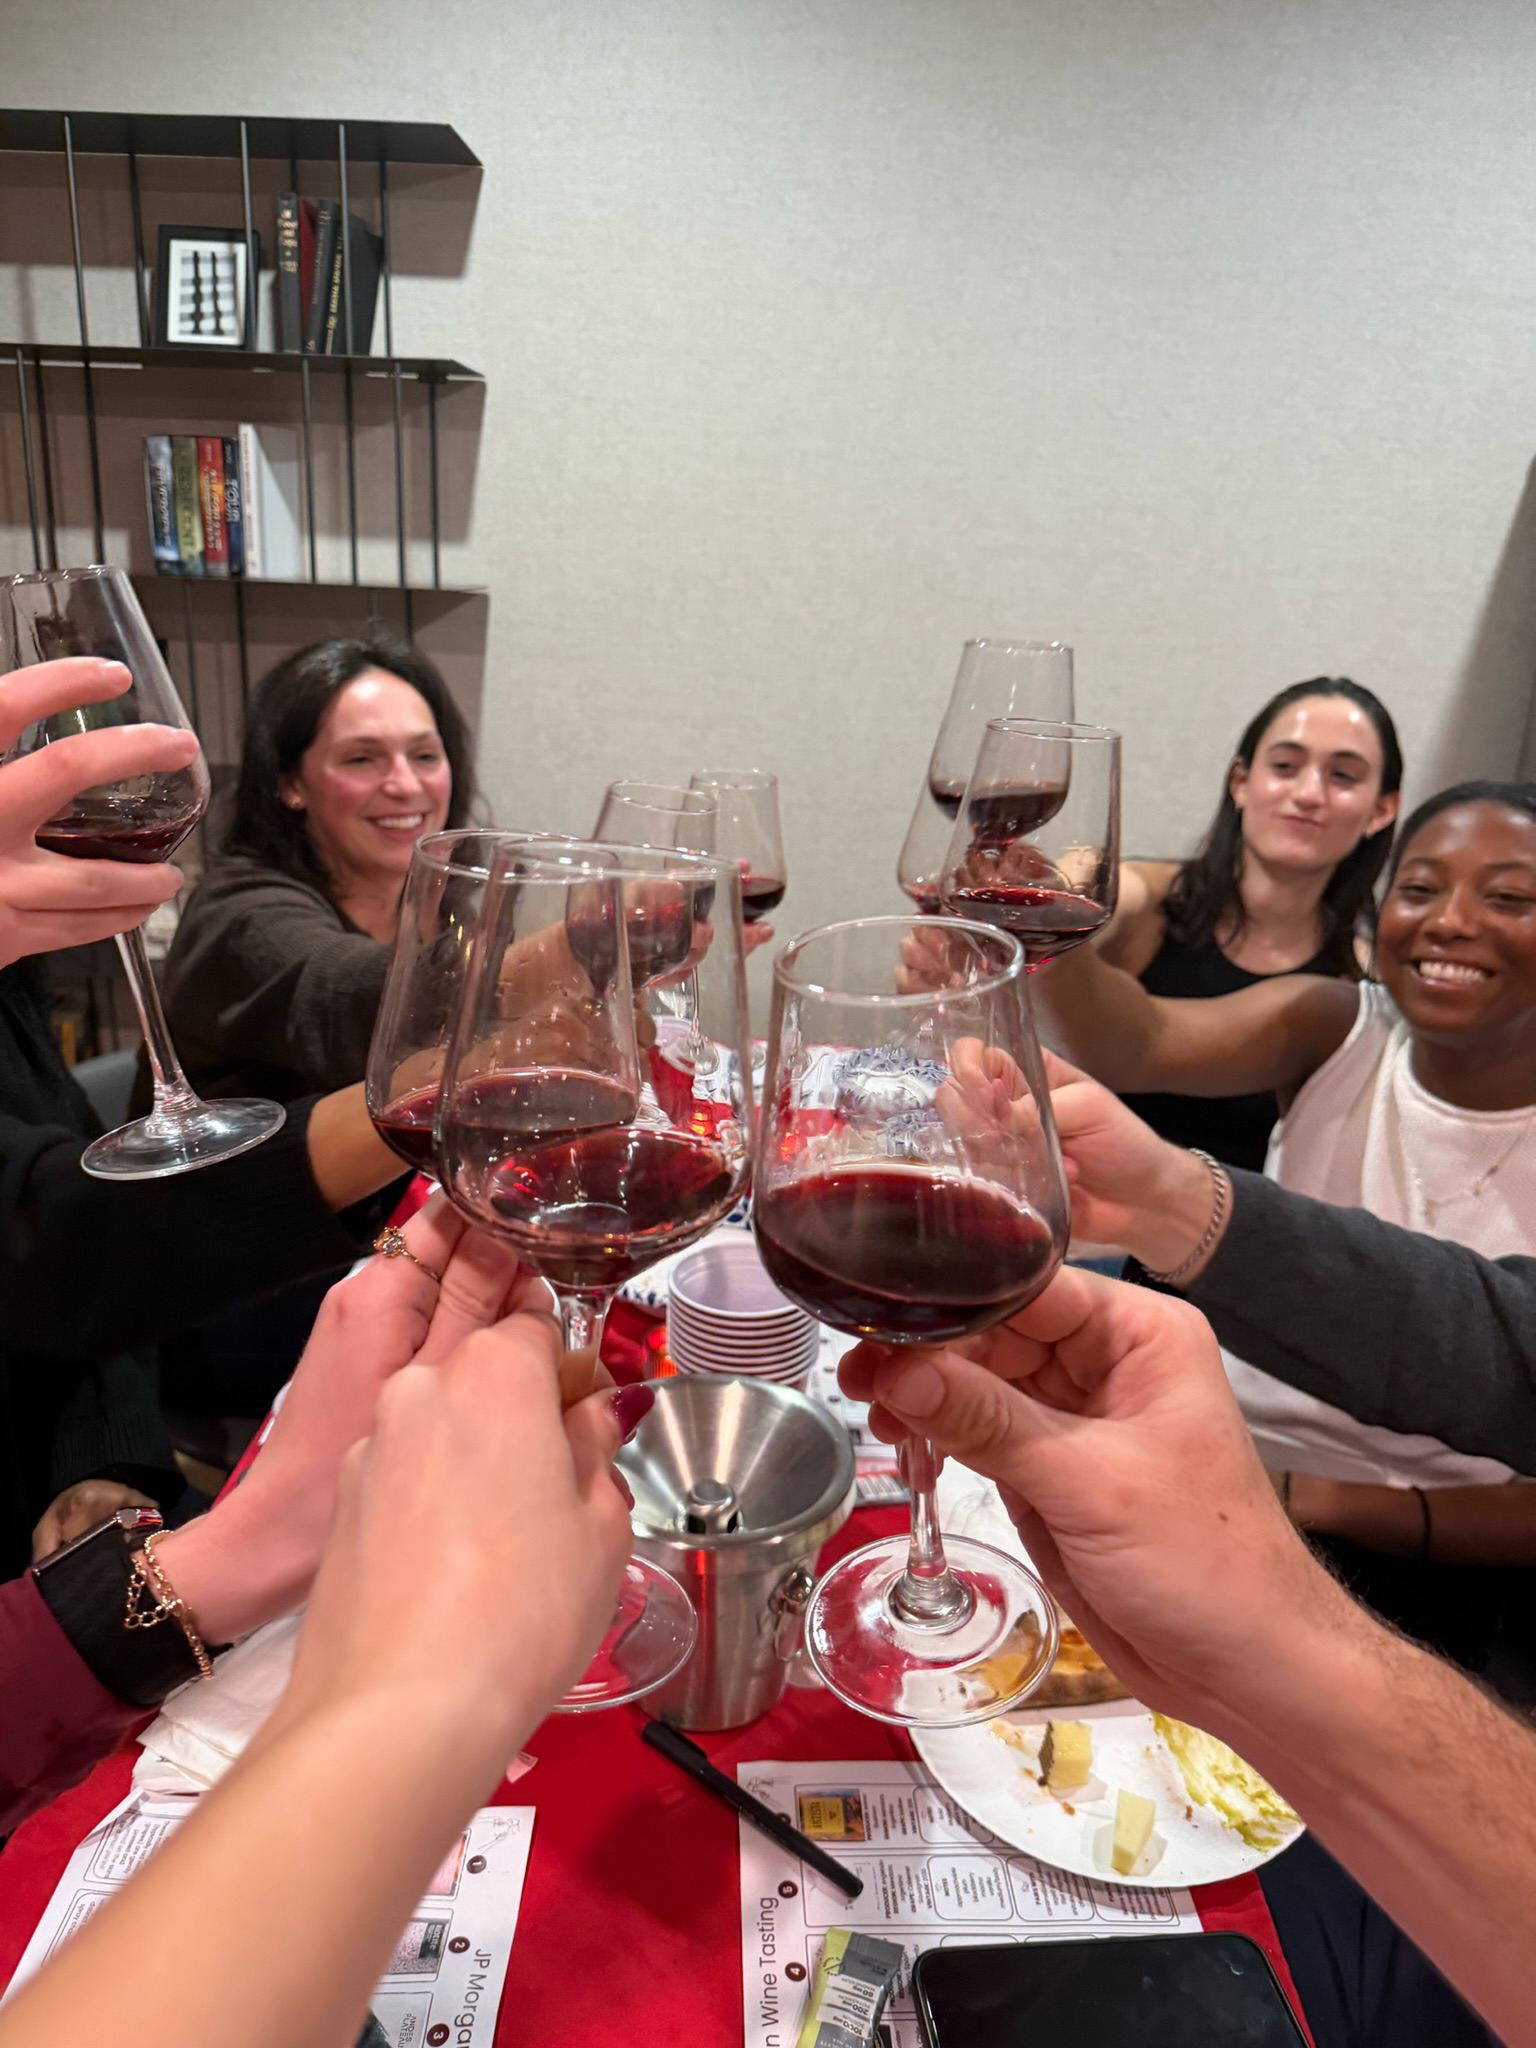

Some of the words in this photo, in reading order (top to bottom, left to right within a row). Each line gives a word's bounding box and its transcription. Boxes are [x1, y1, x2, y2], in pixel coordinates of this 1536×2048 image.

[756, 1897, 779, 1968] Tasting
[454, 1941, 466, 1949] 2
[473, 1948, 492, 1969] JP
[790, 1967, 801, 1975] 4
[454, 1973, 487, 2048] Morga
[759, 1973, 779, 2027] Wine
[407, 2015, 417, 2043] ANDES
[433, 2031, 444, 2040] 3
